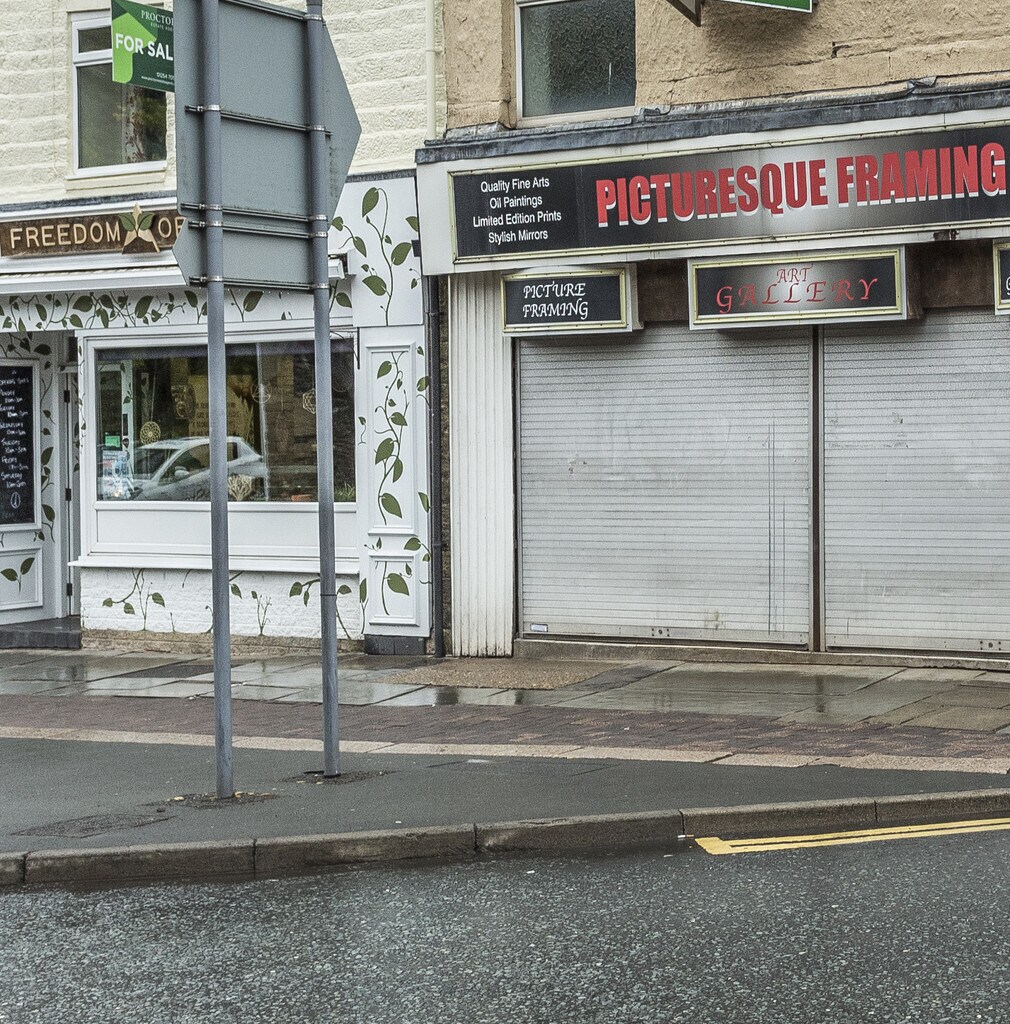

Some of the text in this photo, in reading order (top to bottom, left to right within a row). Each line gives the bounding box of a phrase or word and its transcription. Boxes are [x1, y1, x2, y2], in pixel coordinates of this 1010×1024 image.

[115, 33, 174, 61] FOR SAL
[480, 176, 550, 194] Quality Fine Arts
[595, 142, 1007, 228] PICTURESQUE FRAMING
[489, 194, 543, 209] Oil Paintings
[473, 210, 562, 228] Limited Edition Prints
[9, 220, 121, 249] FREEDOM
[488, 229, 549, 245] Stylish Mirrors
[776, 263, 814, 284] ART
[523, 281, 586, 299] PICTURE
[715, 278, 878, 314] GALLERY
[522, 298, 589, 320] FRAMING
